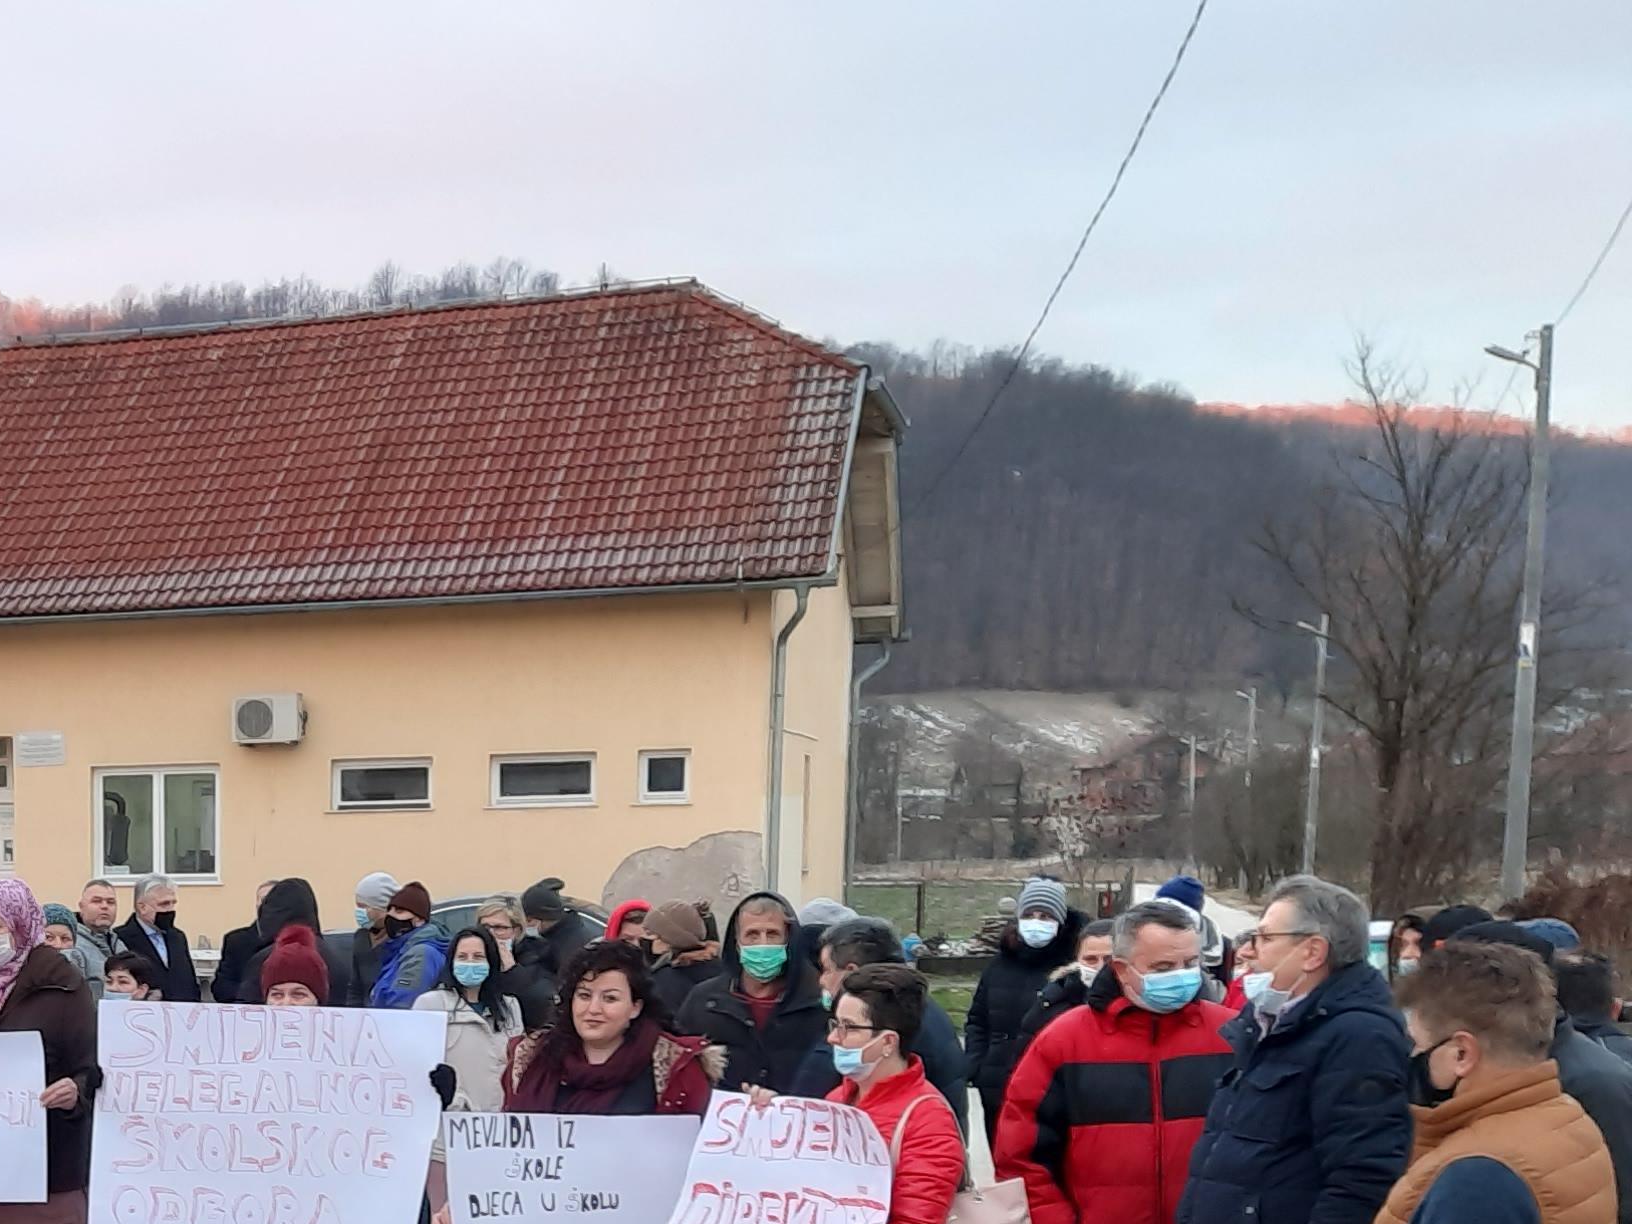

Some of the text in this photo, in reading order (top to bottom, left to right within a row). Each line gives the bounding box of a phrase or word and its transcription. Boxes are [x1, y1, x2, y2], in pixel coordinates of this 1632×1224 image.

[108, 1002, 395, 1069] SMIJENA
[449, 1114, 535, 1150] MEVLIDA
[469, 1191, 524, 1218] DJECA
[540, 1192, 556, 1212] U
